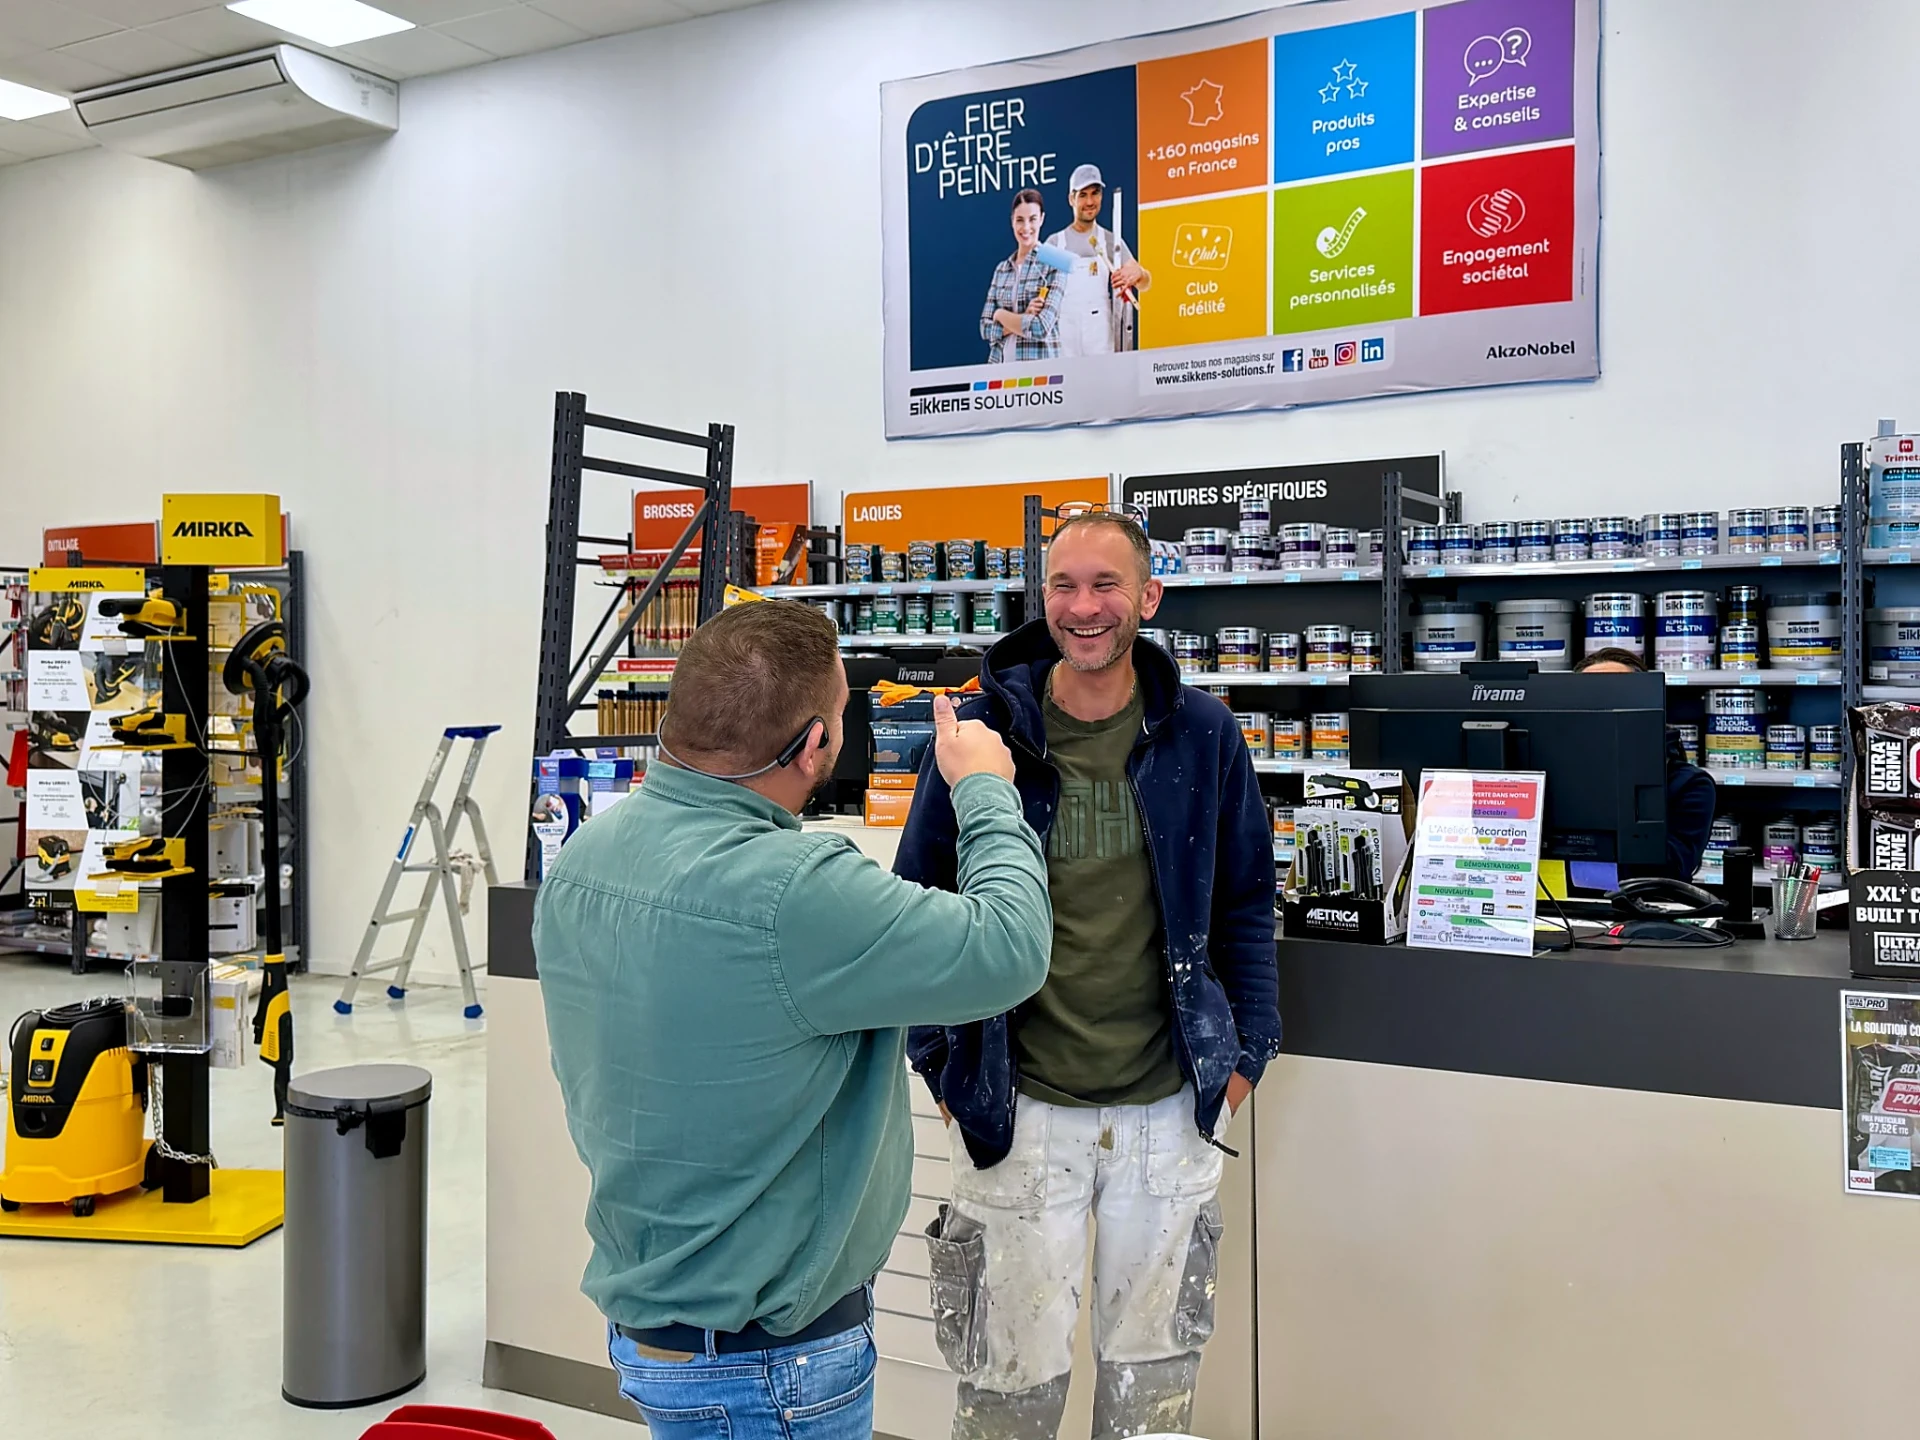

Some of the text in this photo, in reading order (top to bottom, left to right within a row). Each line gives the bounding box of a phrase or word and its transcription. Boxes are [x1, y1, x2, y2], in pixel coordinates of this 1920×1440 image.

[1458, 85, 1537, 113] Expertise
[965, 97, 1026, 135] FIER
[1311, 112, 1375, 135] Produits
[1454, 106, 1541, 132] & conseils
[914, 130, 1013, 174] D'ÊTRE
[1147, 133, 1260, 162] +160 magasins
[1325, 136, 1360, 157] pros
[939, 153, 1057, 200] PEINTRE
[1167, 157, 1238, 179] en France
[1442, 237, 1551, 267] Engagement
[1309, 262, 1375, 284] Services
[1462, 264, 1529, 285] sociétal
[1185, 280, 1219, 297] Club
[1289, 279, 1396, 310] personnalisés
[1178, 297, 1226, 318] fidélité
[1486, 340, 1575, 359] AkzoNobel
[1153, 352, 1275, 373] Retrouvez tous nos magasins sur
[1155, 364, 1275, 385] www.sikkens-solutions.fr
[910, 390, 1064, 416] sikkens SOLUTIONS
[1133, 480, 1328, 508] PEINTURES SPÉCIFIQUES
[643, 502, 695, 520] BROSSES
[853, 503, 903, 521] LAQUES
[171, 521, 254, 538] MIRKA
[47, 537, 80, 553] OUTILLAGE
[67, 580, 106, 589] MIRKA
[1593, 602, 1631, 612] sikkens
[1665, 599, 1704, 611] sikkens
[1604, 625, 1630, 633] SATIN
[897, 666, 935, 682] iiyama
[1471, 684, 1526, 702] iiyama
[1715, 698, 1755, 709] sikkens
[1870, 740, 1885, 791] ULTRA
[1885, 740, 1901, 792] GRIME
[1482, 808, 1508, 816] octobre
[1472, 826, 1528, 837] Décoration
[1876, 833, 1890, 870] LTRA
[1891, 833, 1907, 870] RIME
[1463, 860, 1521, 869] DÉMONSTRATIONS
[1434, 887, 1475, 896] NOUVEAUTÉS
[1306, 908, 1359, 923] METRICA
[1856, 907, 1920, 924] BUILT T
[1880, 949, 1920, 962] GRIM
[1866, 999, 1886, 1008] PRO
[1850, 1021, 1862, 1033] LA
[1864, 1022, 1908, 1036] SOLUTION
[20, 1093, 56, 1104] MIRKA
